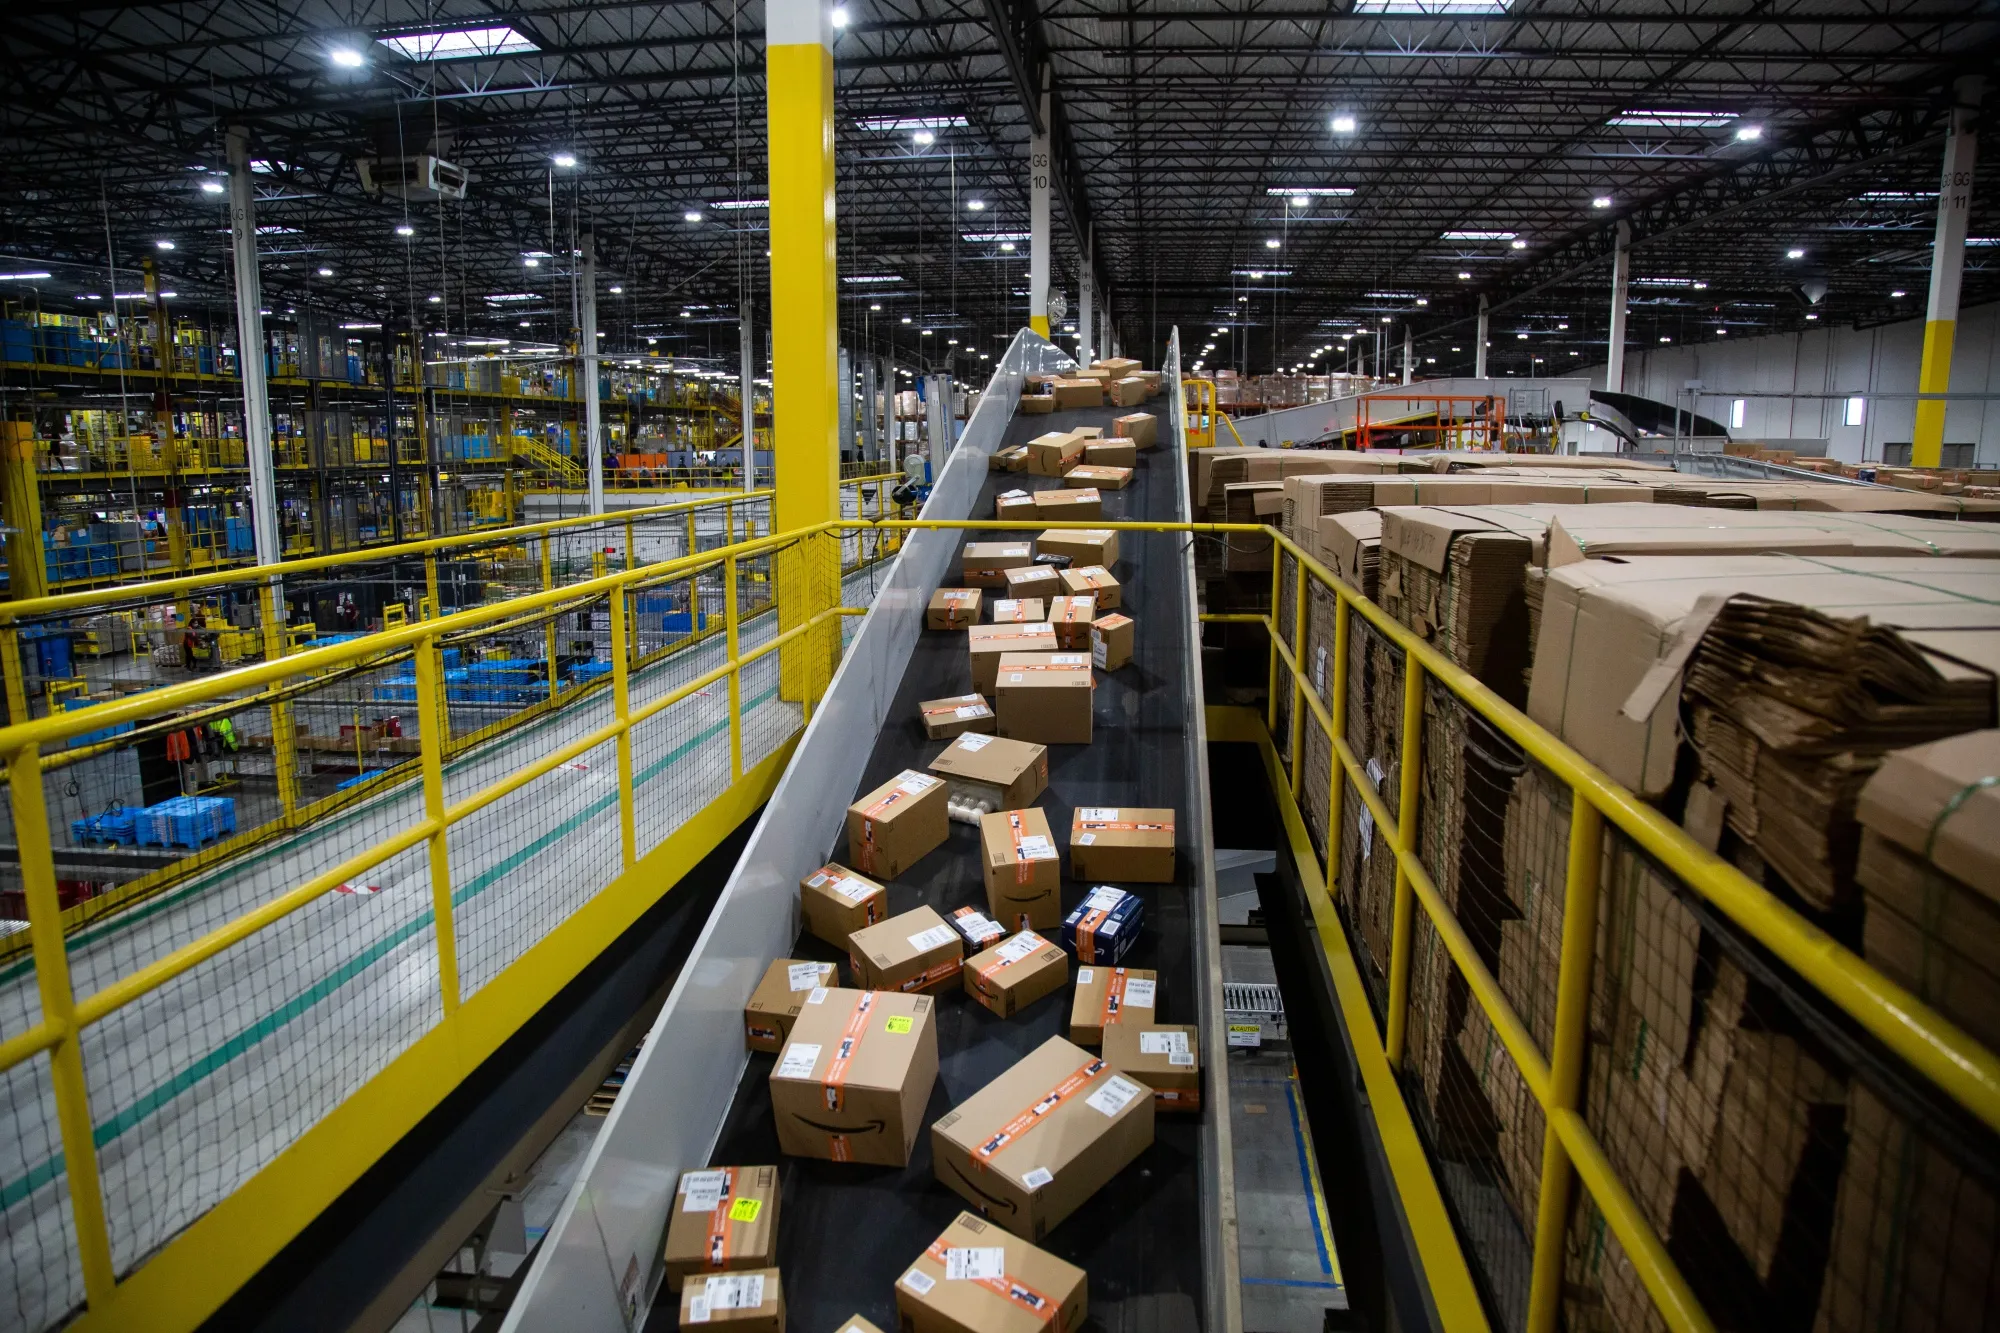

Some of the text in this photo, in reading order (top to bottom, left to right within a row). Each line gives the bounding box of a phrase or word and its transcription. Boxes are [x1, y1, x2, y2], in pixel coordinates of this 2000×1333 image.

[1032, 154, 1047, 168] GG
[1032, 176, 1047, 189] 10
[1954, 172, 1970, 186] GG
[1953, 196, 1966, 208] 11
[1081, 284, 1091, 292] 10
